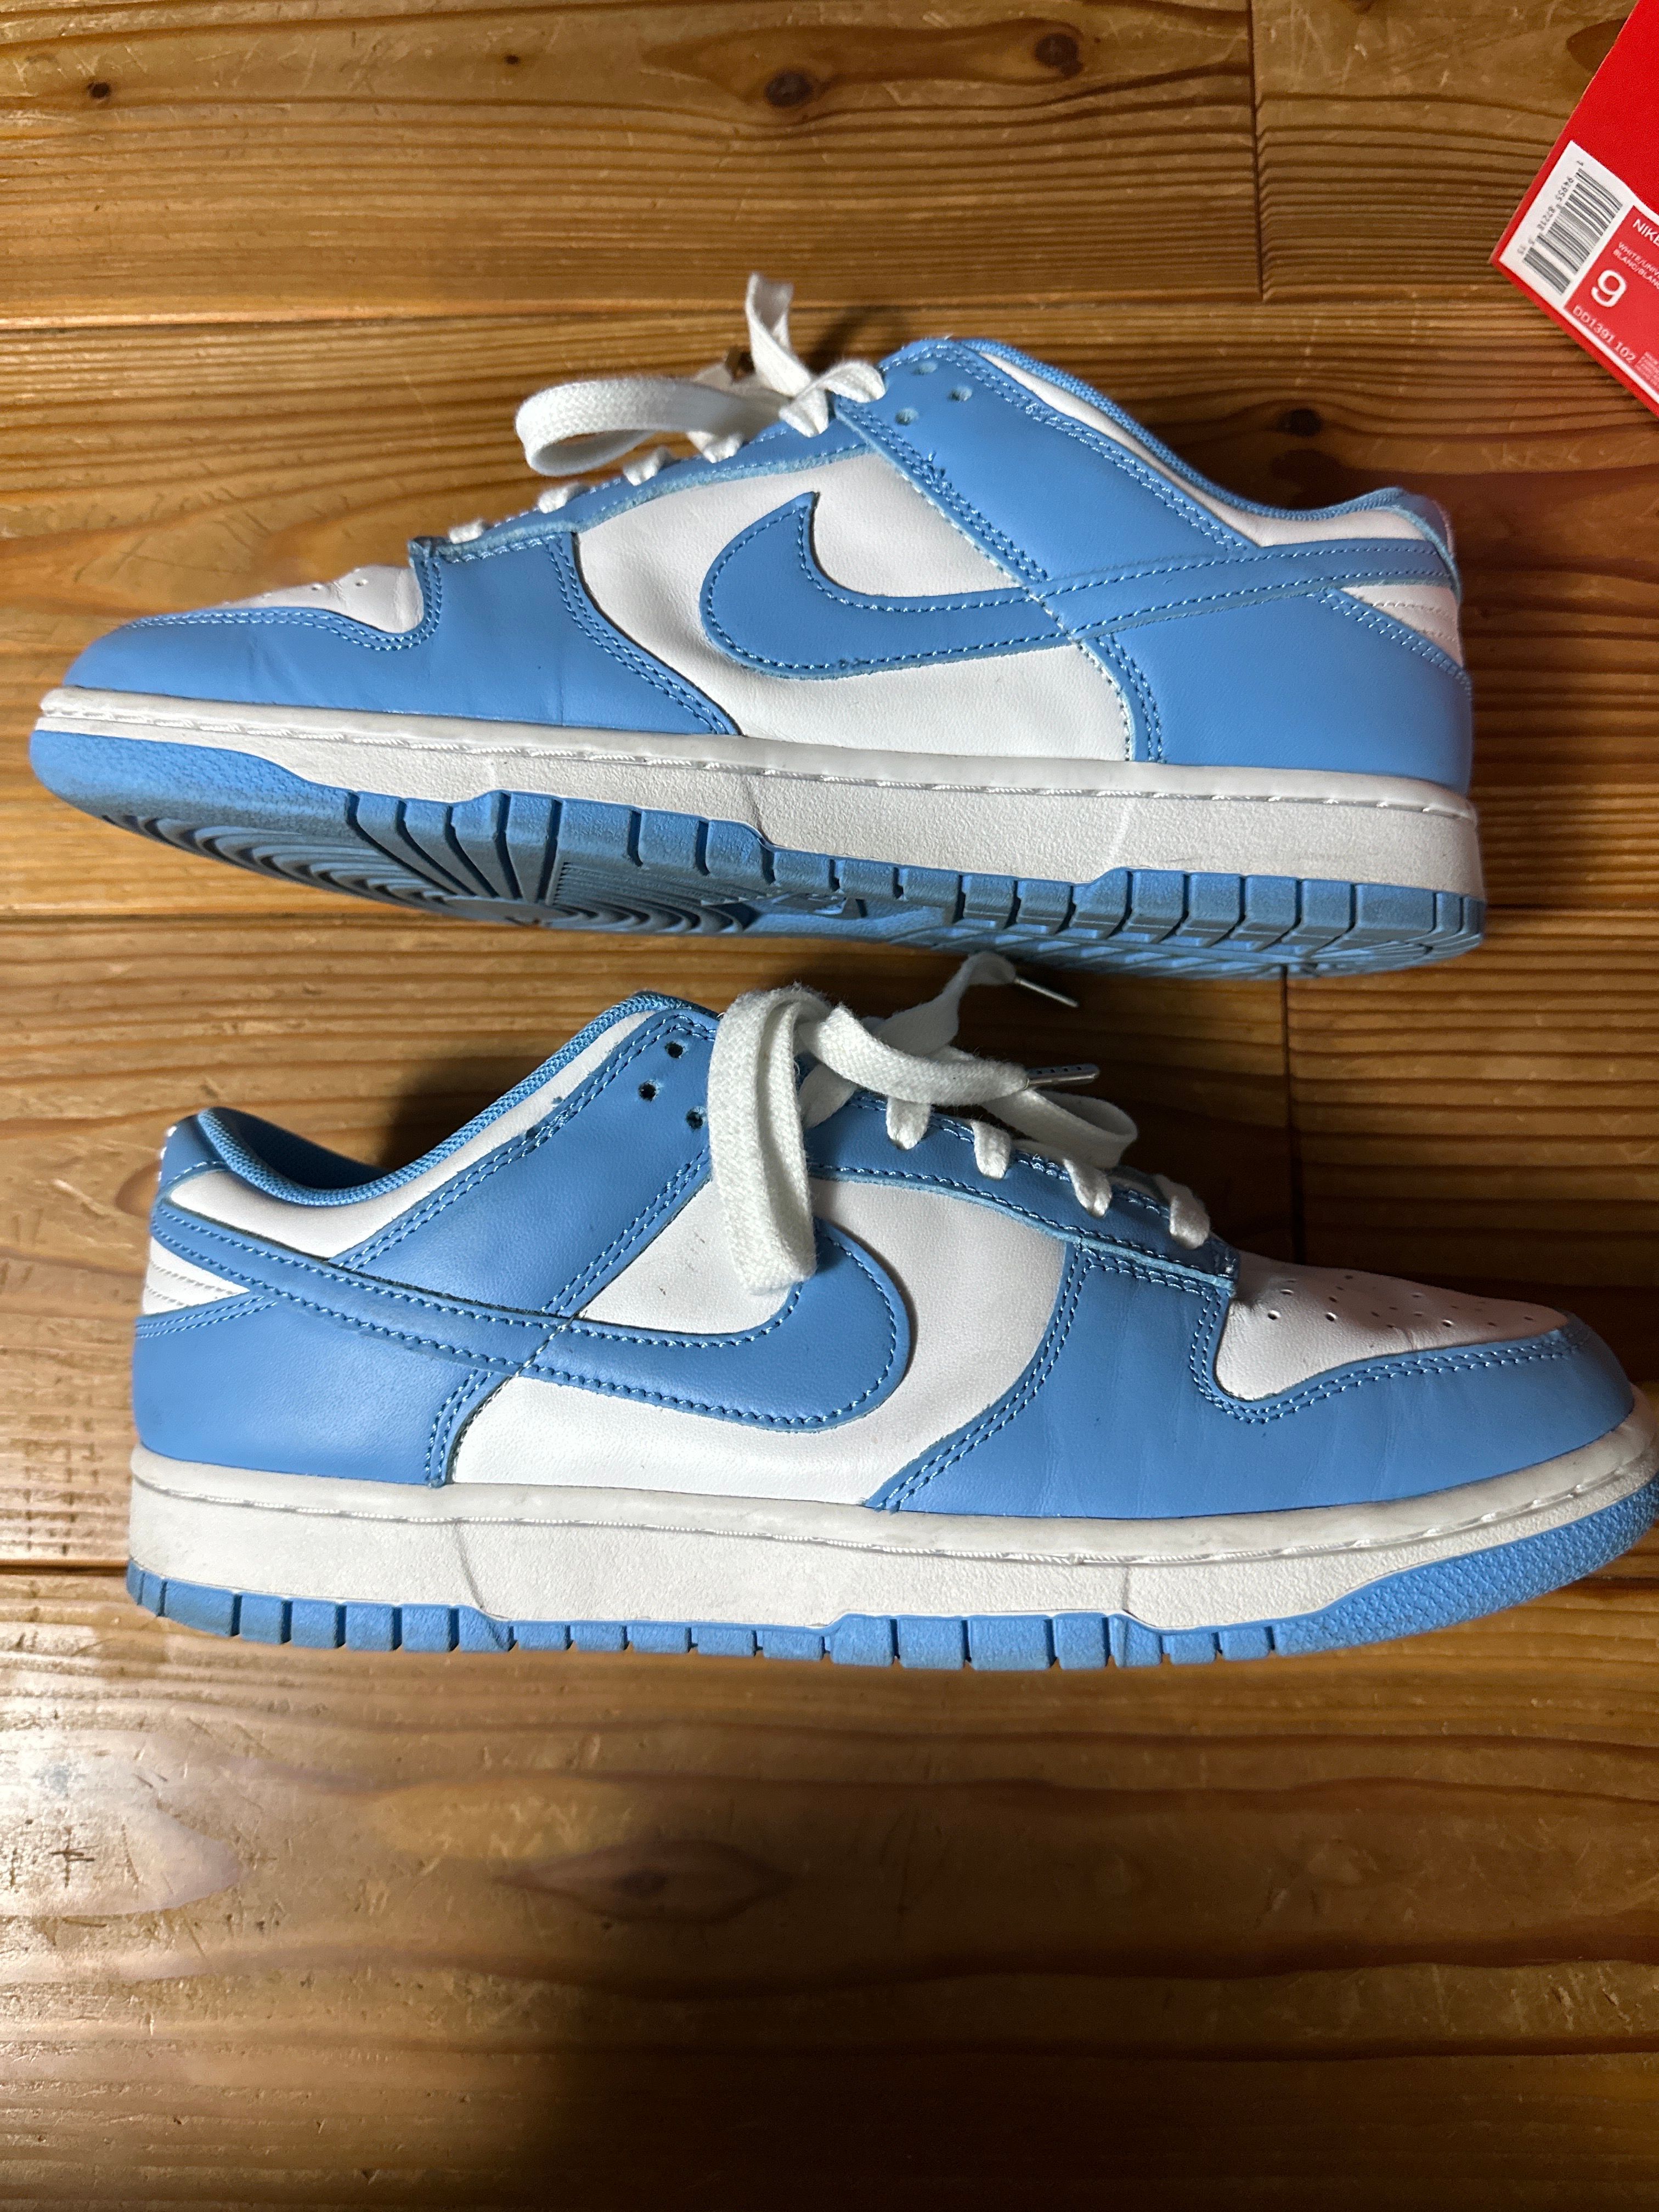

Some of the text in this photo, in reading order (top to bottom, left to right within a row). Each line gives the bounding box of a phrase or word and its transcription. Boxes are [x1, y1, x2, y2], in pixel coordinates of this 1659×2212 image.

[1592, 269, 1627, 307] 9
[1573, 304, 1636, 363] DD1391 102
